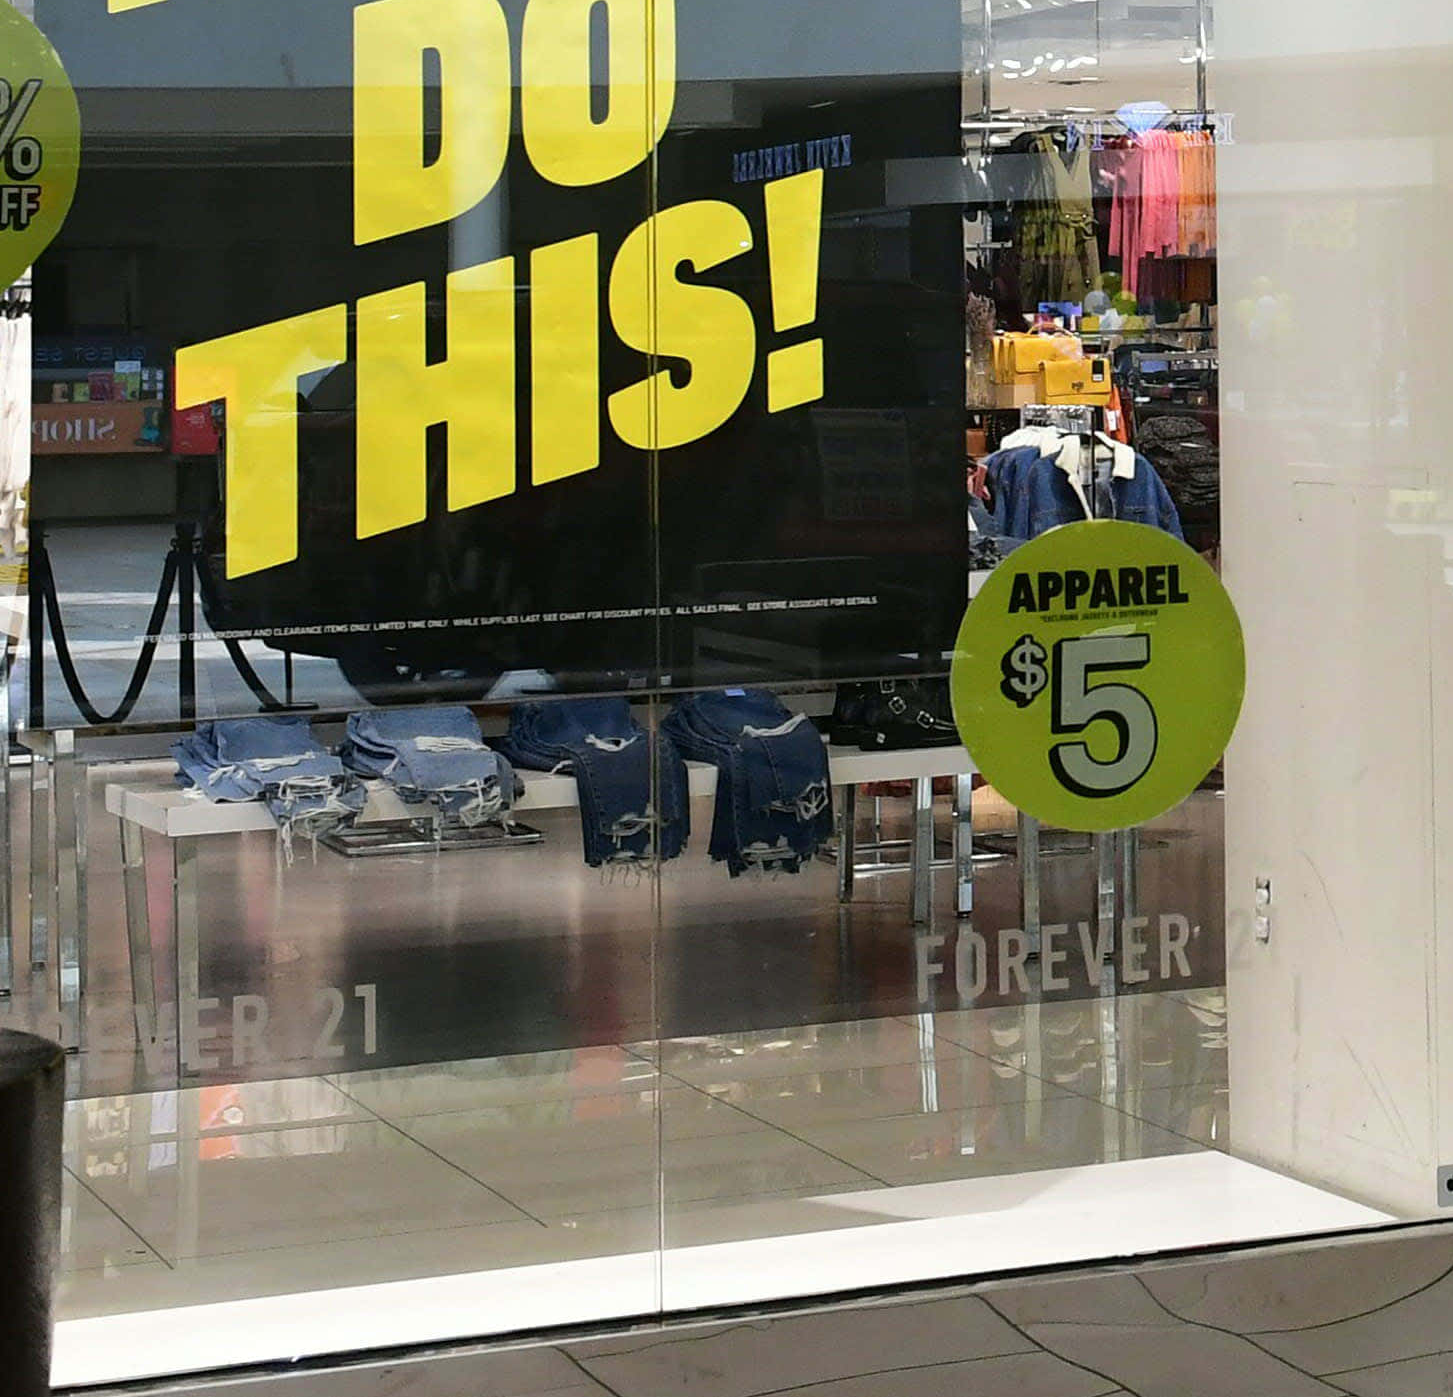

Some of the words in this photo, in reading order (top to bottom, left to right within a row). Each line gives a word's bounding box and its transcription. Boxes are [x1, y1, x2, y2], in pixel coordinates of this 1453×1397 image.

[0, 184, 41, 231] FF
[175, 169, 824, 581] THIS!
[1008, 565, 1189, 613] APPAREL
[273, 625, 322, 636] CLEARANCE
[324, 624, 349, 633] ITEMS
[1000, 633, 1158, 799] $5
[916, 913, 1193, 1003] FOREVER
[313, 984, 377, 1057] 21
